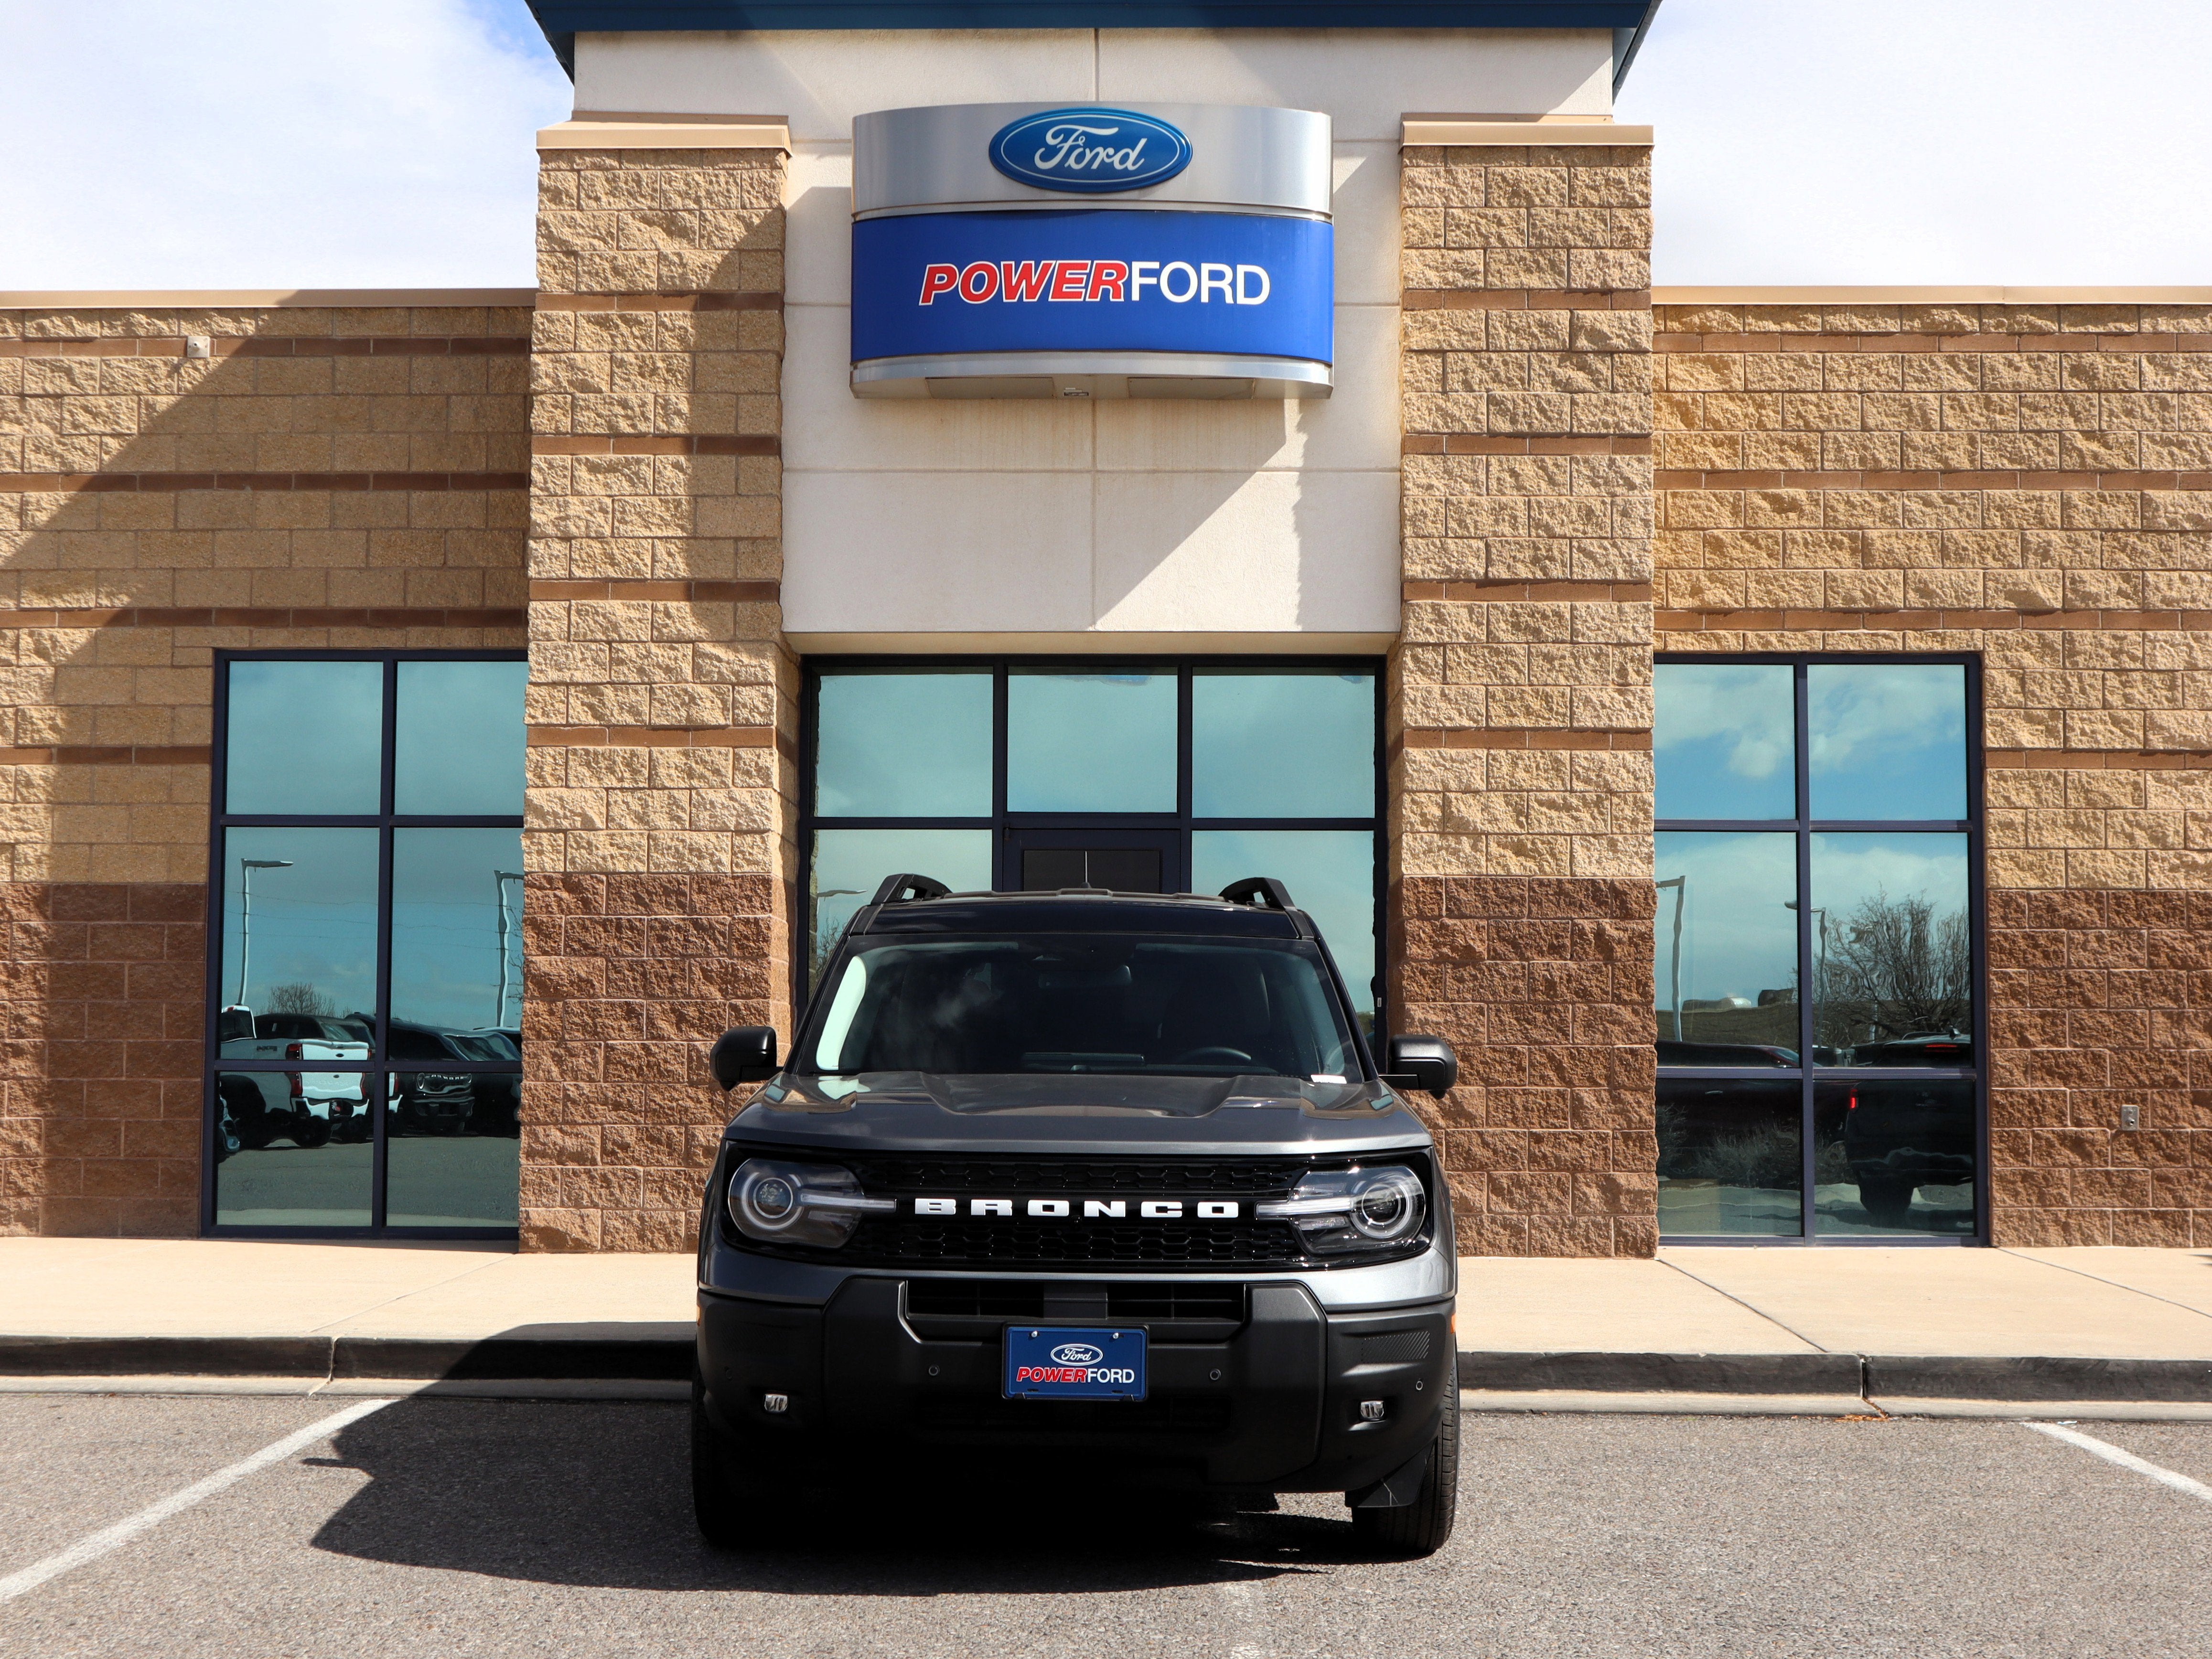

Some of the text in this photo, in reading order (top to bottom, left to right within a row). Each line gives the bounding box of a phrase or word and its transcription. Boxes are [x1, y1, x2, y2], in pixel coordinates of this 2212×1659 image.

[1034, 124, 1147, 170] Ford
[914, 1198, 1239, 1218] BRONCO
[1061, 1348, 1092, 1361] Ford
